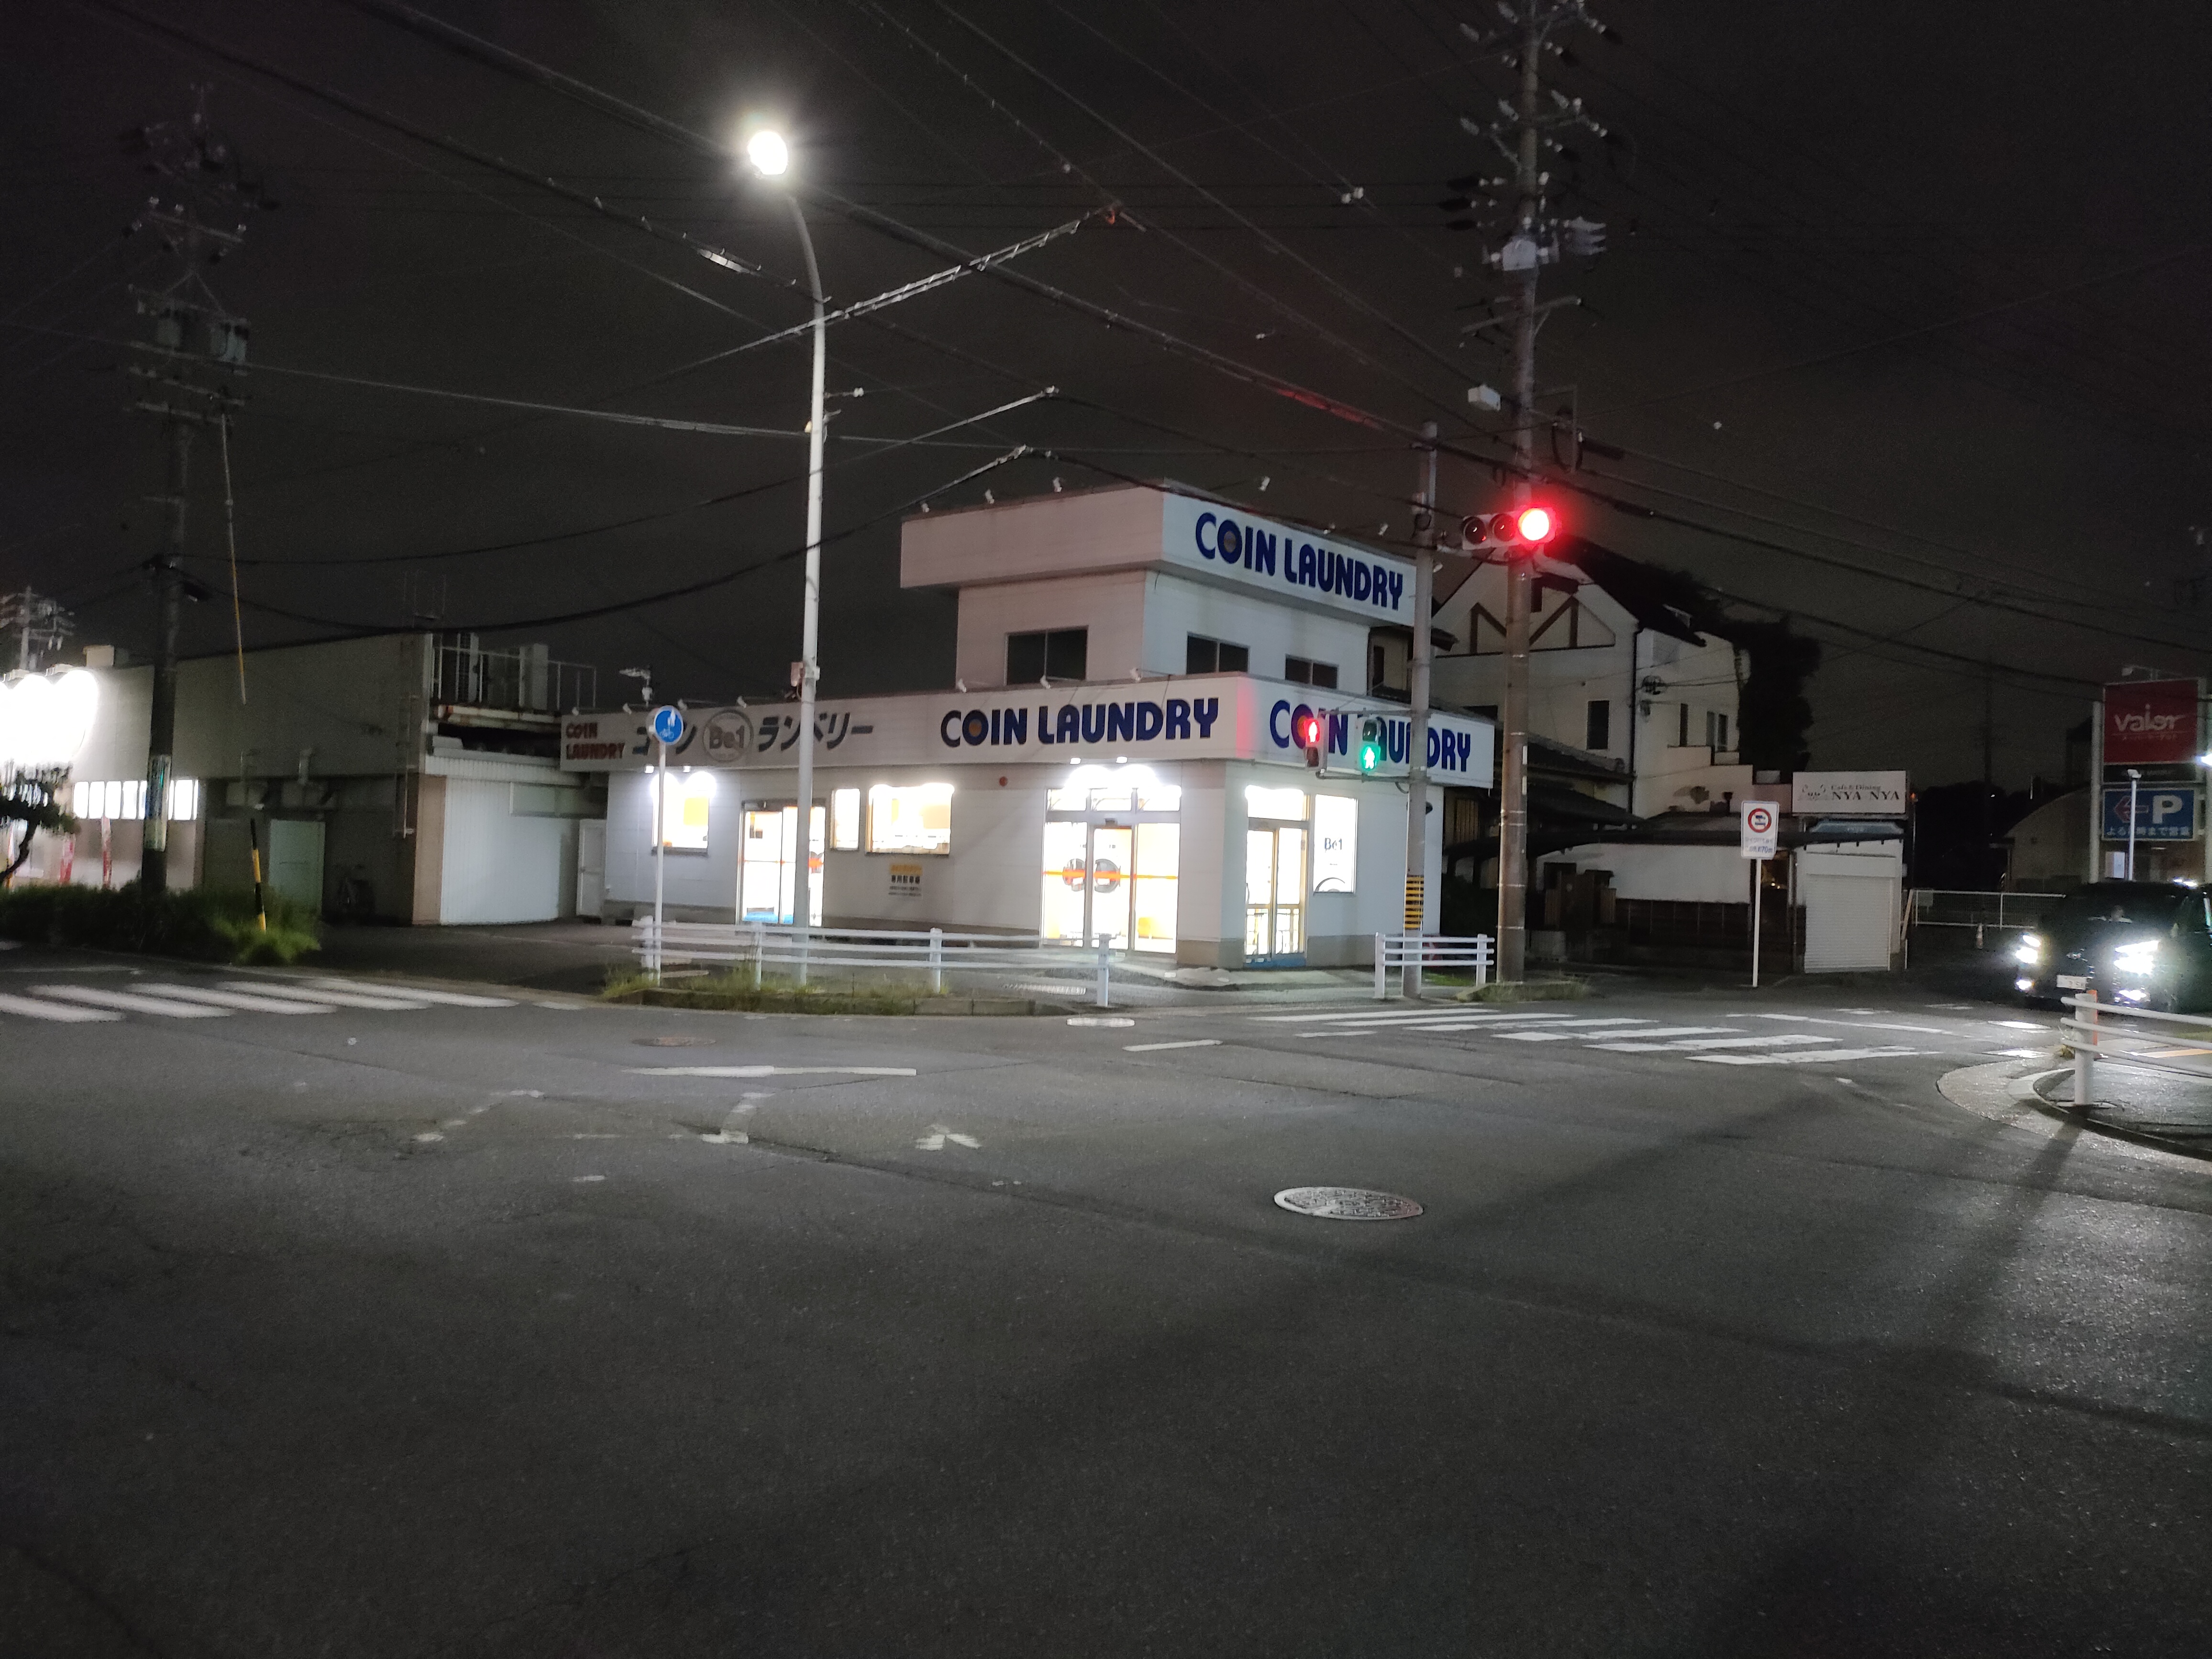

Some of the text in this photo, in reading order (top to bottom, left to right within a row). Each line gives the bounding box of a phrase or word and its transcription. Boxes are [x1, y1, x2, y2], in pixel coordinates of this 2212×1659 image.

[1195, 512, 1403, 611] COIN LAUNDRY
[565, 722, 598, 739] COIN
[940, 697, 1219, 748] COIN LAUNDRY
[1269, 699, 1349, 756] CON
[1832, 791, 1900, 800] NYA NYA
[2153, 795, 2183, 824] P
